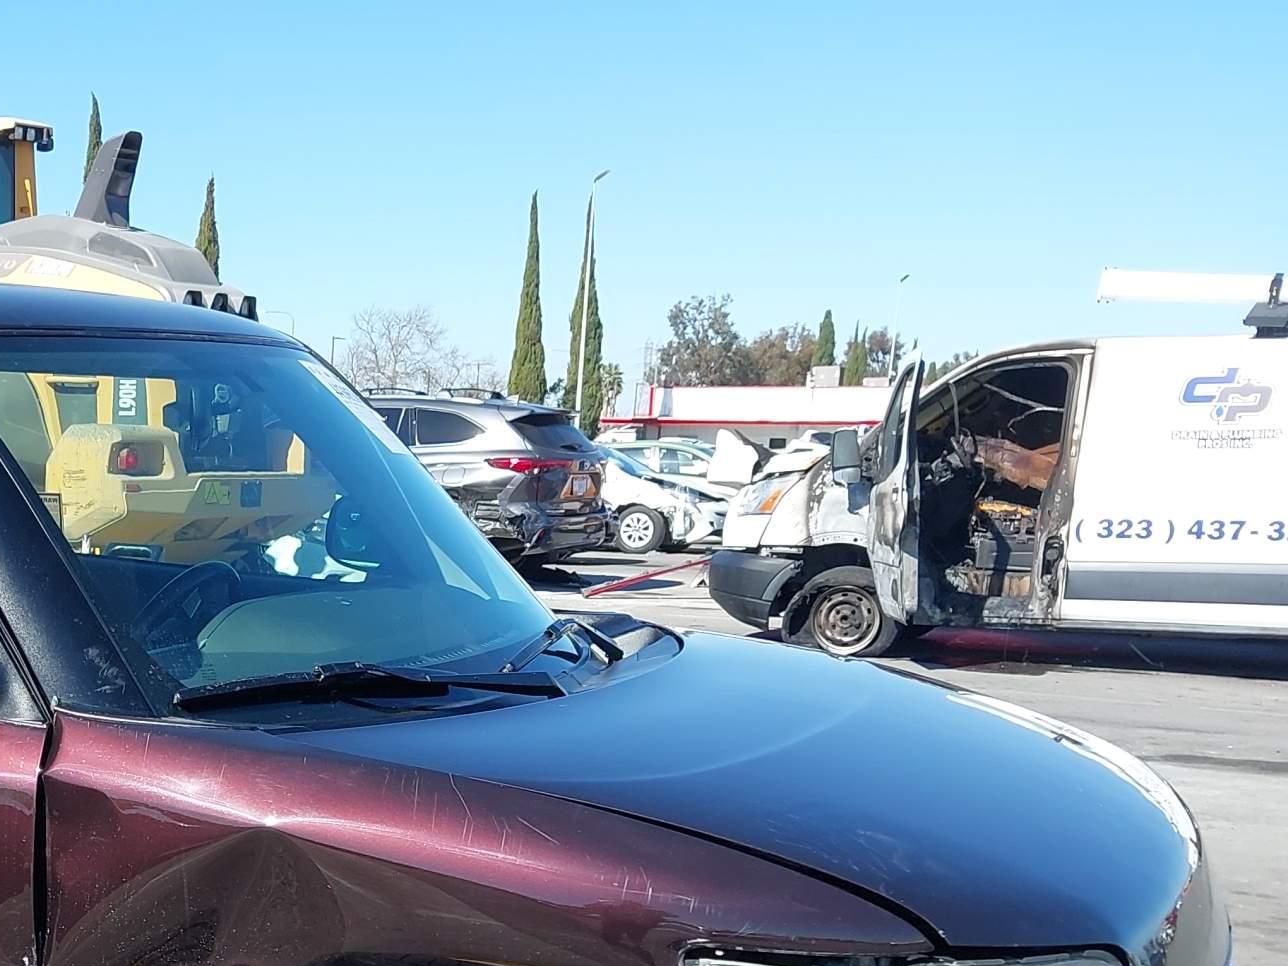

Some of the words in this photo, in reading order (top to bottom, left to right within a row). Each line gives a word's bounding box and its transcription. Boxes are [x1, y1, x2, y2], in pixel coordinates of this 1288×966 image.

[118, 379, 137, 416] L90H
[1170, 430, 1208, 441] DRAIN
[1222, 429, 1284, 440] PLUMBING
